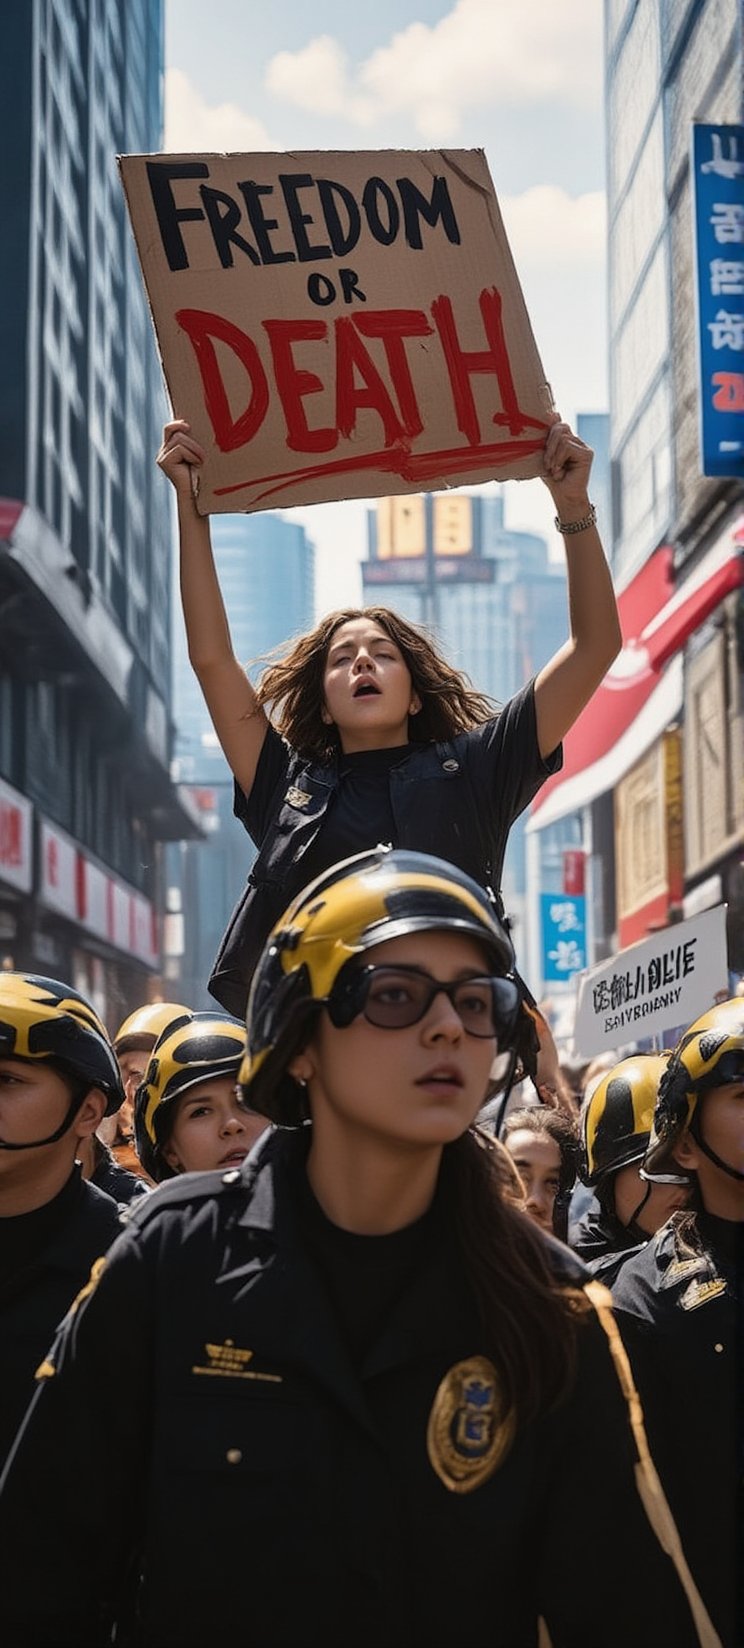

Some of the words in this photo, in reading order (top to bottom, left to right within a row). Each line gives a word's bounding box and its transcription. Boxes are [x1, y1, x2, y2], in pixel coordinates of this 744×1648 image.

[146, 161, 461, 272] FREEDOM
[307, 268, 367, 306] OR
[175, 286, 545, 454] DEATH
